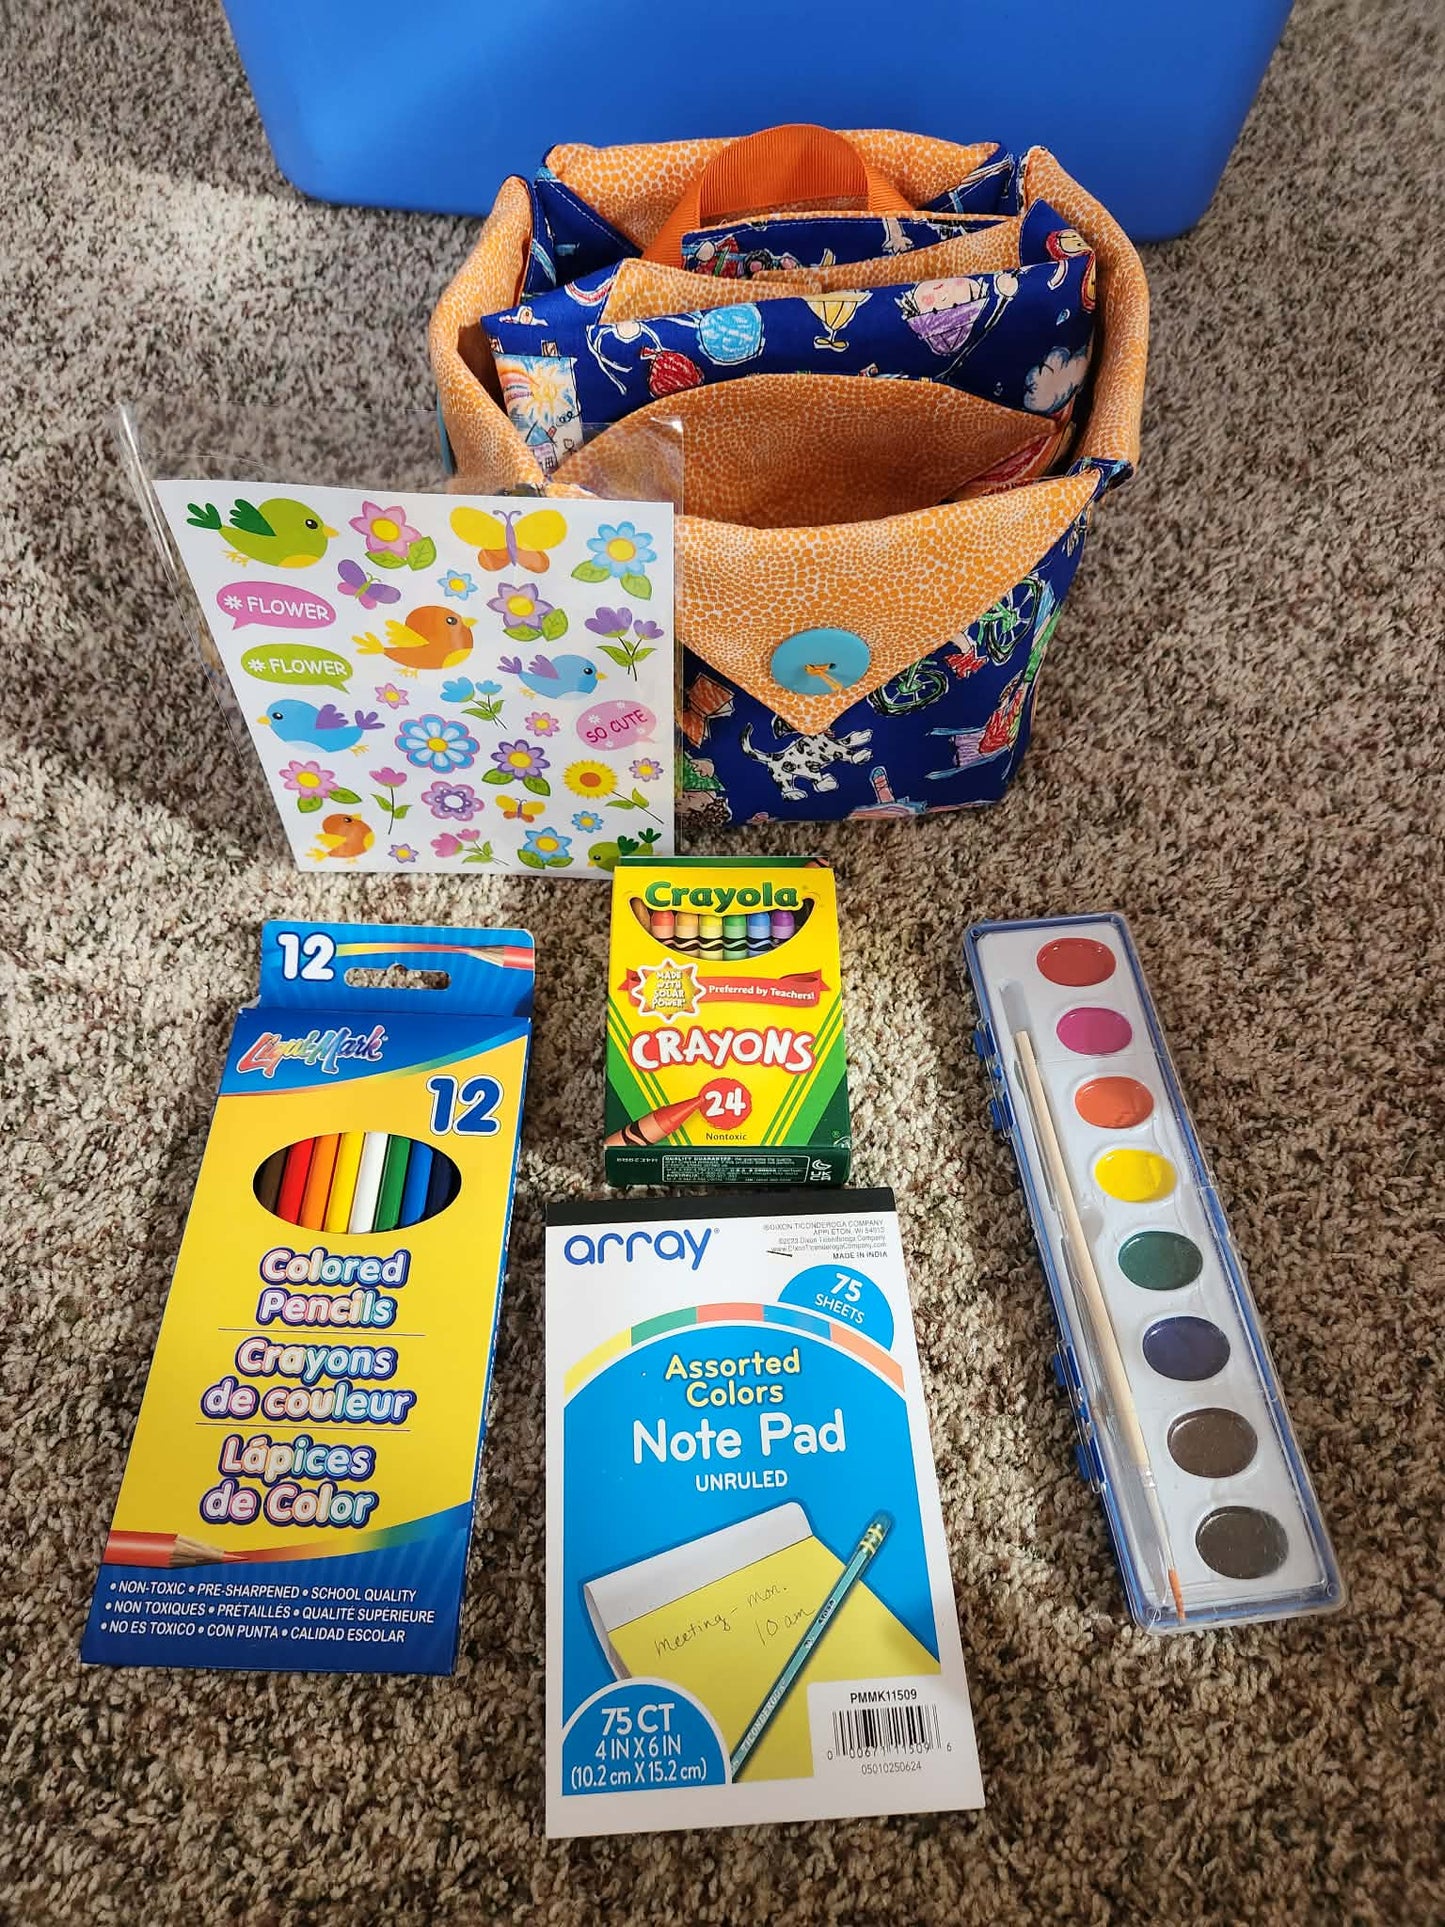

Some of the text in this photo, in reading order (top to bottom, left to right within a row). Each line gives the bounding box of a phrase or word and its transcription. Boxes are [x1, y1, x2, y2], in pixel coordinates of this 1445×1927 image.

[246, 596, 330, 620] FLOWER
[269, 658, 347, 676] FLOWER
[586, 709, 648, 743] SO CUTE
[644, 881, 800, 913] Crayola
[277, 932, 336, 981] 12
[656, 971, 683, 980] MADE
[656, 980, 682, 989] WITH
[653, 989, 686, 999] SOLAR
[709, 985, 815, 1000] Preferred by Teachers!
[630, 1028, 816, 1073] CRAYONS
[427, 1075, 504, 1137] 12
[704, 1087, 747, 1118] 24
[705, 1132, 748, 1141] Nontoxic
[848, 1219, 884, 1228] COMPANY
[261, 1248, 410, 1287] Colored
[833, 1252, 855, 1260] MADE
[866, 1250, 888, 1258] INDIA
[830, 1272, 863, 1302] 75
[257, 1288, 397, 1327] Pencils
[814, 1293, 865, 1324] SHEETS
[236, 1338, 398, 1385] Crayons
[665, 1348, 801, 1381] Assorted
[202, 1377, 416, 1423] de couleur
[686, 1381, 784, 1408] Colors
[633, 1408, 847, 1465] Note Pad
[220, 1435, 375, 1486] Lápices
[695, 1470, 788, 1492] UNRULED
[201, 1479, 379, 1527] de Color
[118, 1580, 417, 1603] NON-TOXIC PRE-SHARPENED SCHOOL QUALITY
[114, 1600, 435, 1623] NON TOXIQUES PRÉTAILLÉS QUALITÉ SUPÉRIEURE
[109, 1620, 406, 1643] NO ES TOXICO CON PUNTA CALIDAD ESCOLAR
[755, 1619, 778, 1647] 10
[784, 1608, 816, 1628] am
[850, 1688, 917, 1704] PMMK11509
[601, 1703, 675, 1736] 75 CT
[595, 1734, 681, 1760] 4 IN X 6 IN
[827, 1750, 834, 1760] 0
[946, 1742, 952, 1752] 6
[571, 1757, 707, 1790] (10.2 cm X 15.2 cm)
[861, 1761, 921, 1775] 05010250624
